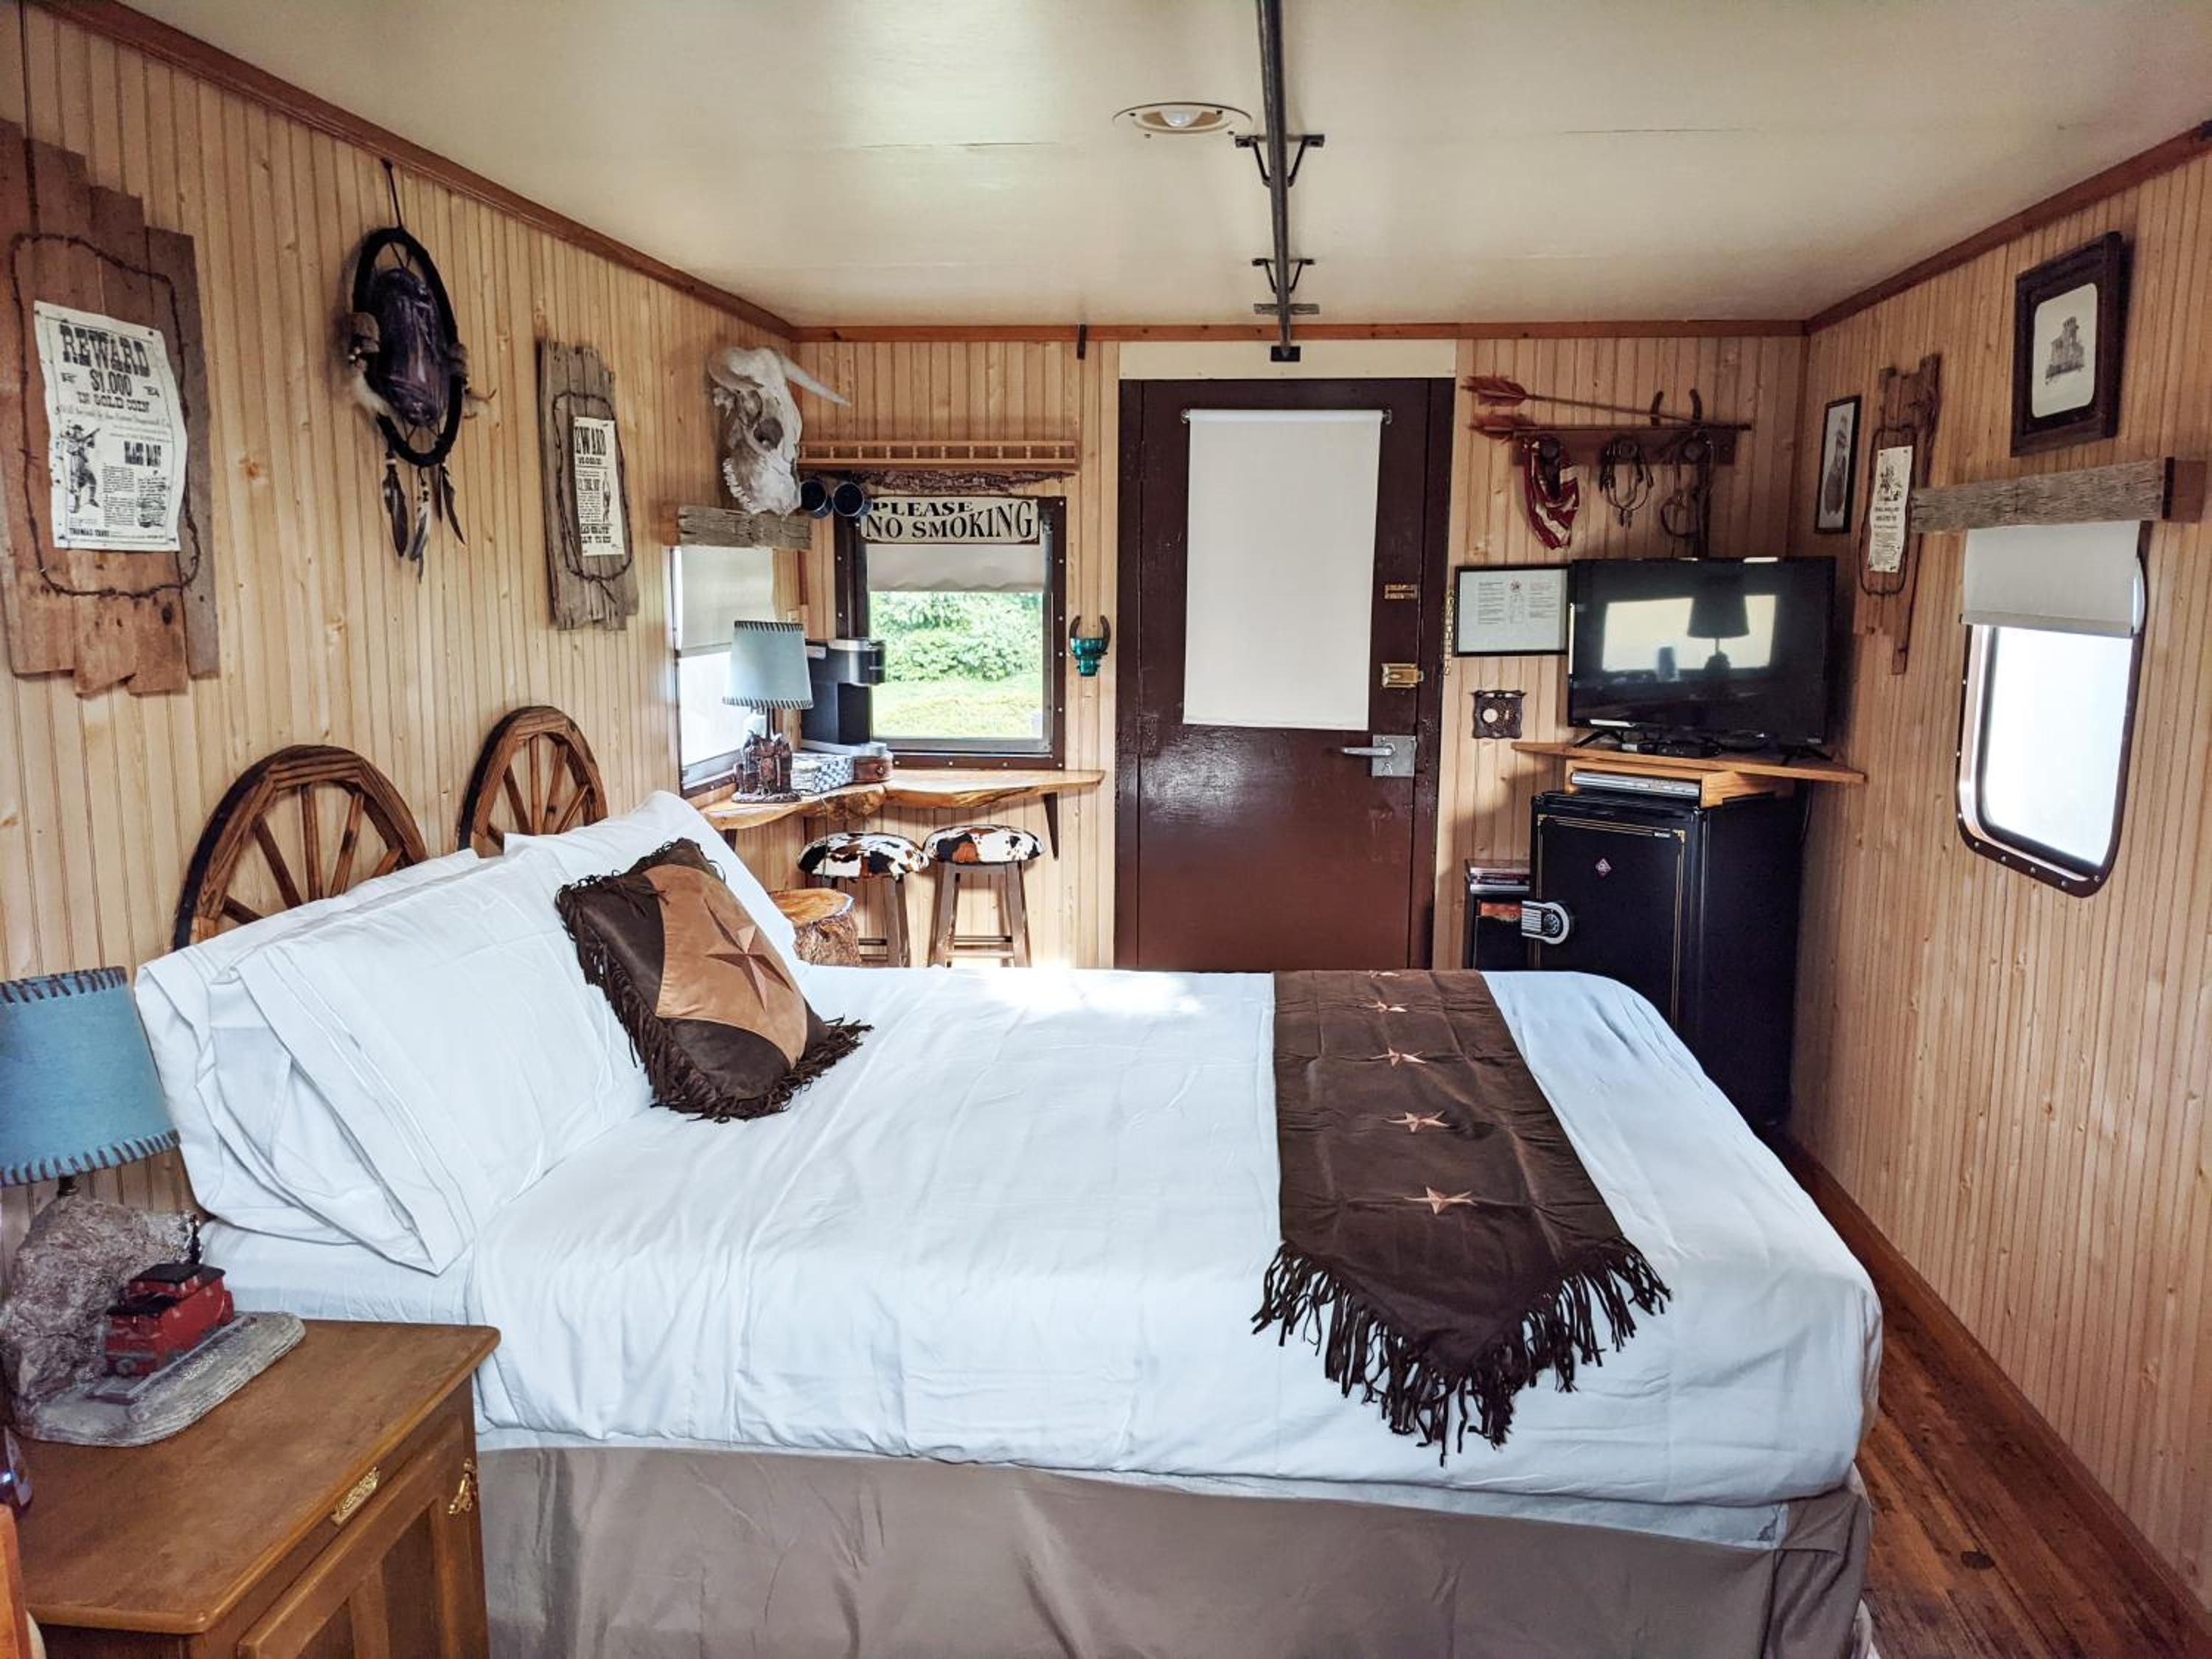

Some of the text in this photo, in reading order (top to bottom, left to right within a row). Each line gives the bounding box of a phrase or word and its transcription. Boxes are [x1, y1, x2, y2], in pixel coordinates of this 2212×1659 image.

[59, 324, 150, 378] REWARD
[94, 394, 125, 409] GOLD
[574, 425, 607, 456] EWARD
[866, 501, 1032, 538] NO SMOKING
[872, 501, 973, 517] PLEASE
